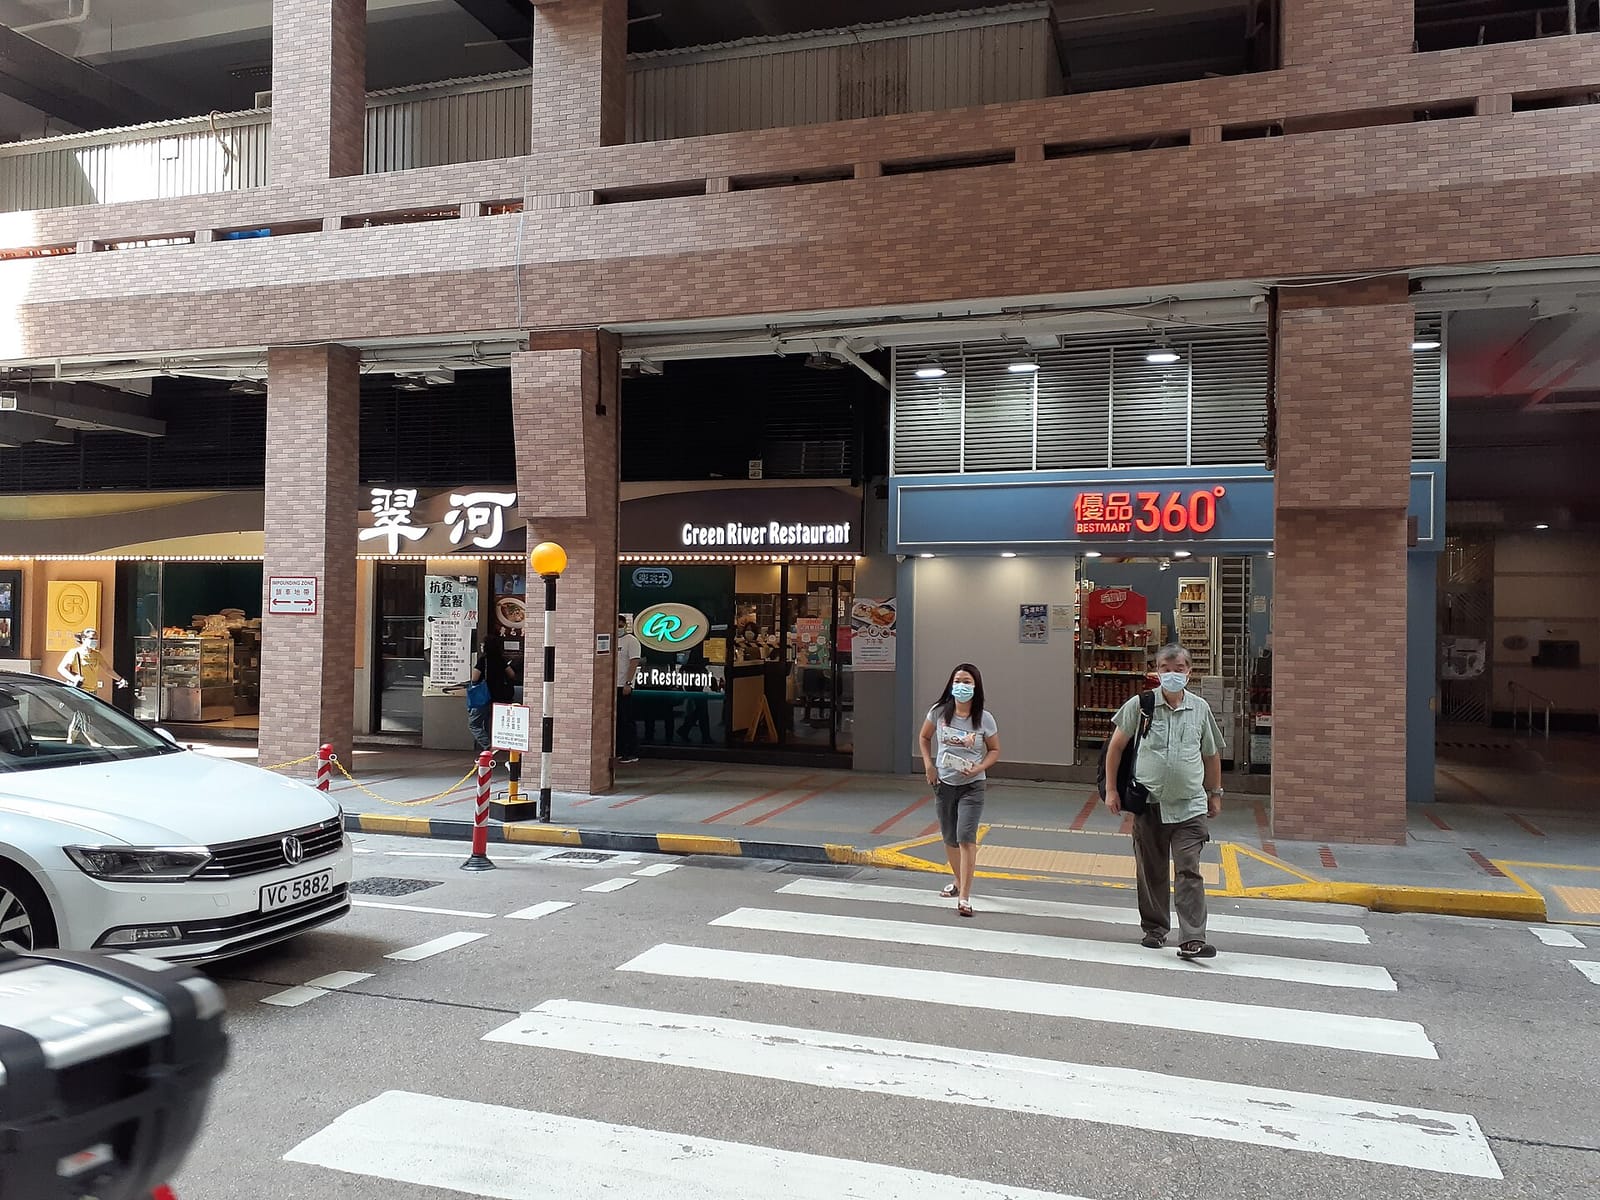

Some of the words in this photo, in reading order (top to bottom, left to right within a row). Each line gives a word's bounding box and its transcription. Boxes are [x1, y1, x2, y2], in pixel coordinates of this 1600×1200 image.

[1074, 492, 1133, 521] 優品
[359, 488, 516, 555] 翠河
[1076, 522, 1132, 533] BESTMART
[682, 522, 725, 546] Green
[727, 522, 767, 545] River
[769, 521, 850, 545] Restaurant
[430, 581, 453, 594] 抗疫
[440, 594, 463, 608] 套餐
[651, 668, 713, 687] Restaurant
[267, 885, 288, 907] VC
[292, 874, 329, 900] 5882
